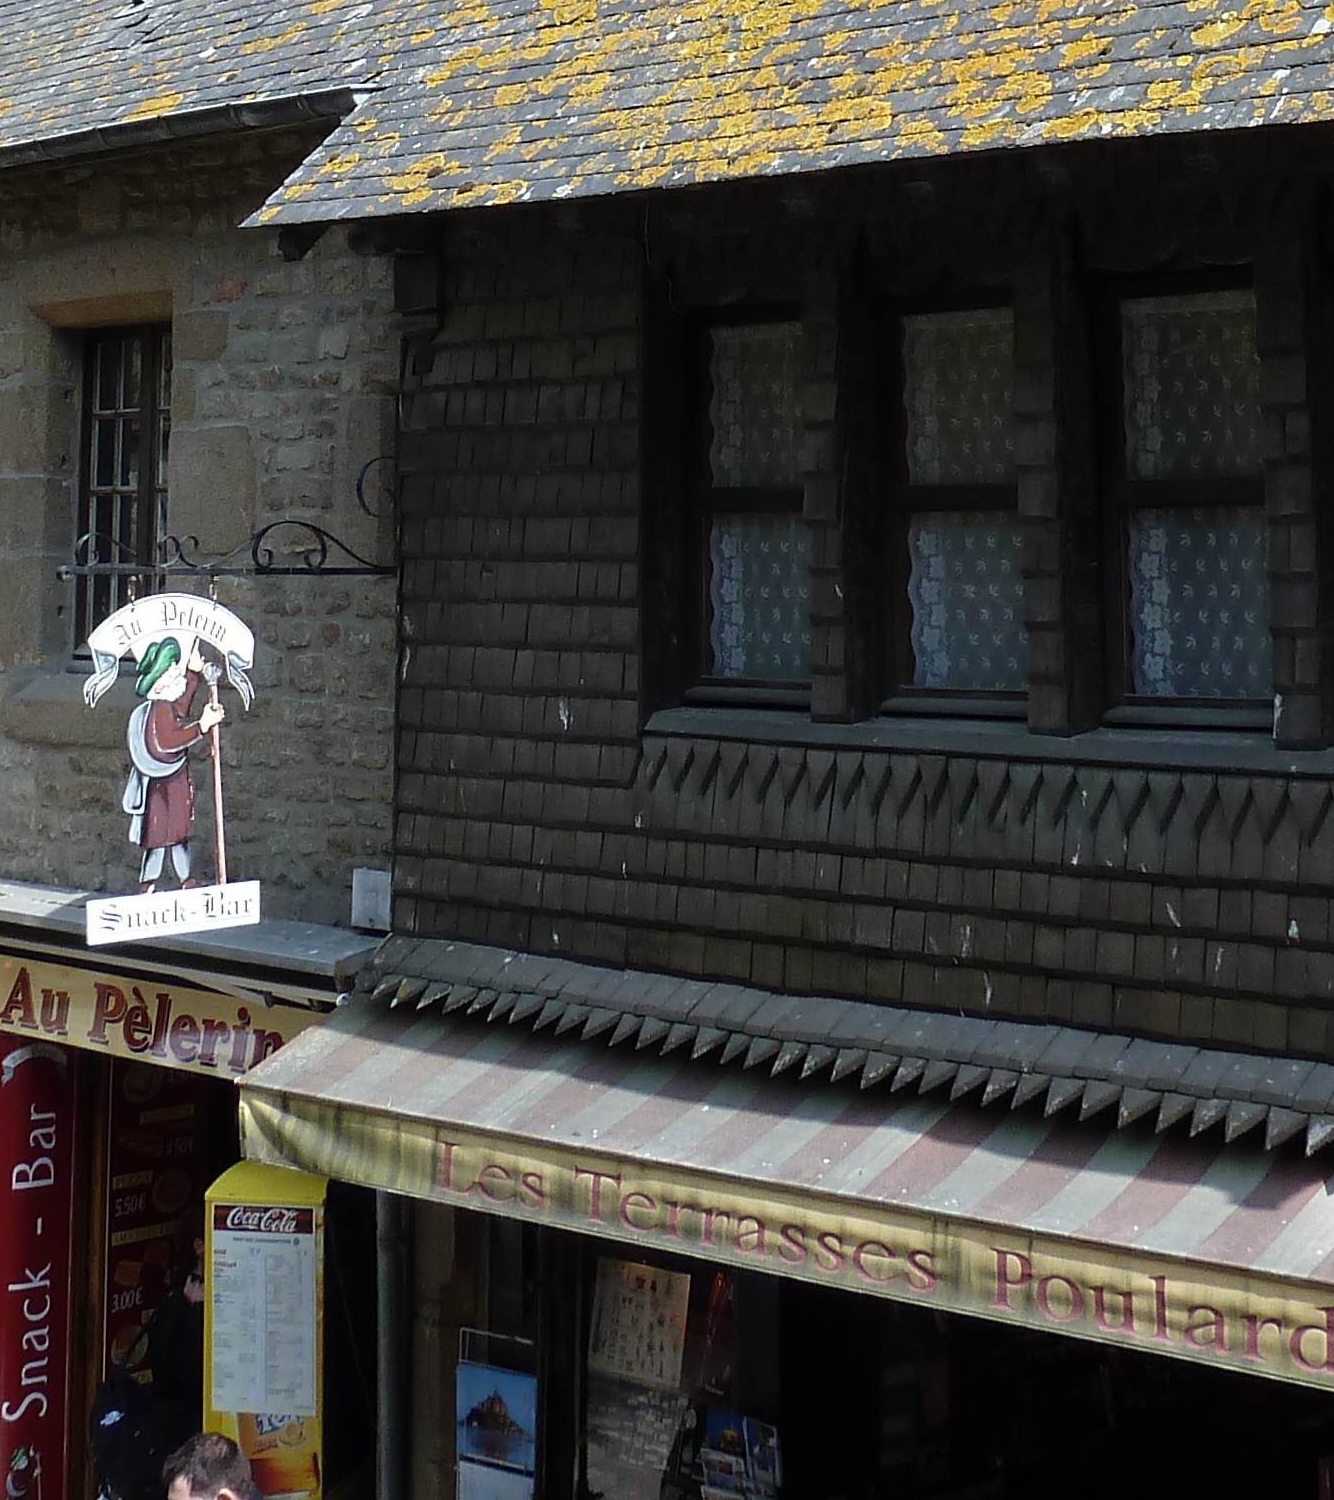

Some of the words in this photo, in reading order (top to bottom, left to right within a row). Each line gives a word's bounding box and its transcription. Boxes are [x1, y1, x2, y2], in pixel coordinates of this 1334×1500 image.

[113, 619, 142, 645] Au
[0, 966, 70, 1036] Au
[87, 981, 286, 1074] Pèlerin
[11, 1103, 57, 1191] Bar
[438, 1141, 546, 1210] Les
[574, 1164, 938, 1293] Terrasses
[1, 1262, 52, 1423] Snack
